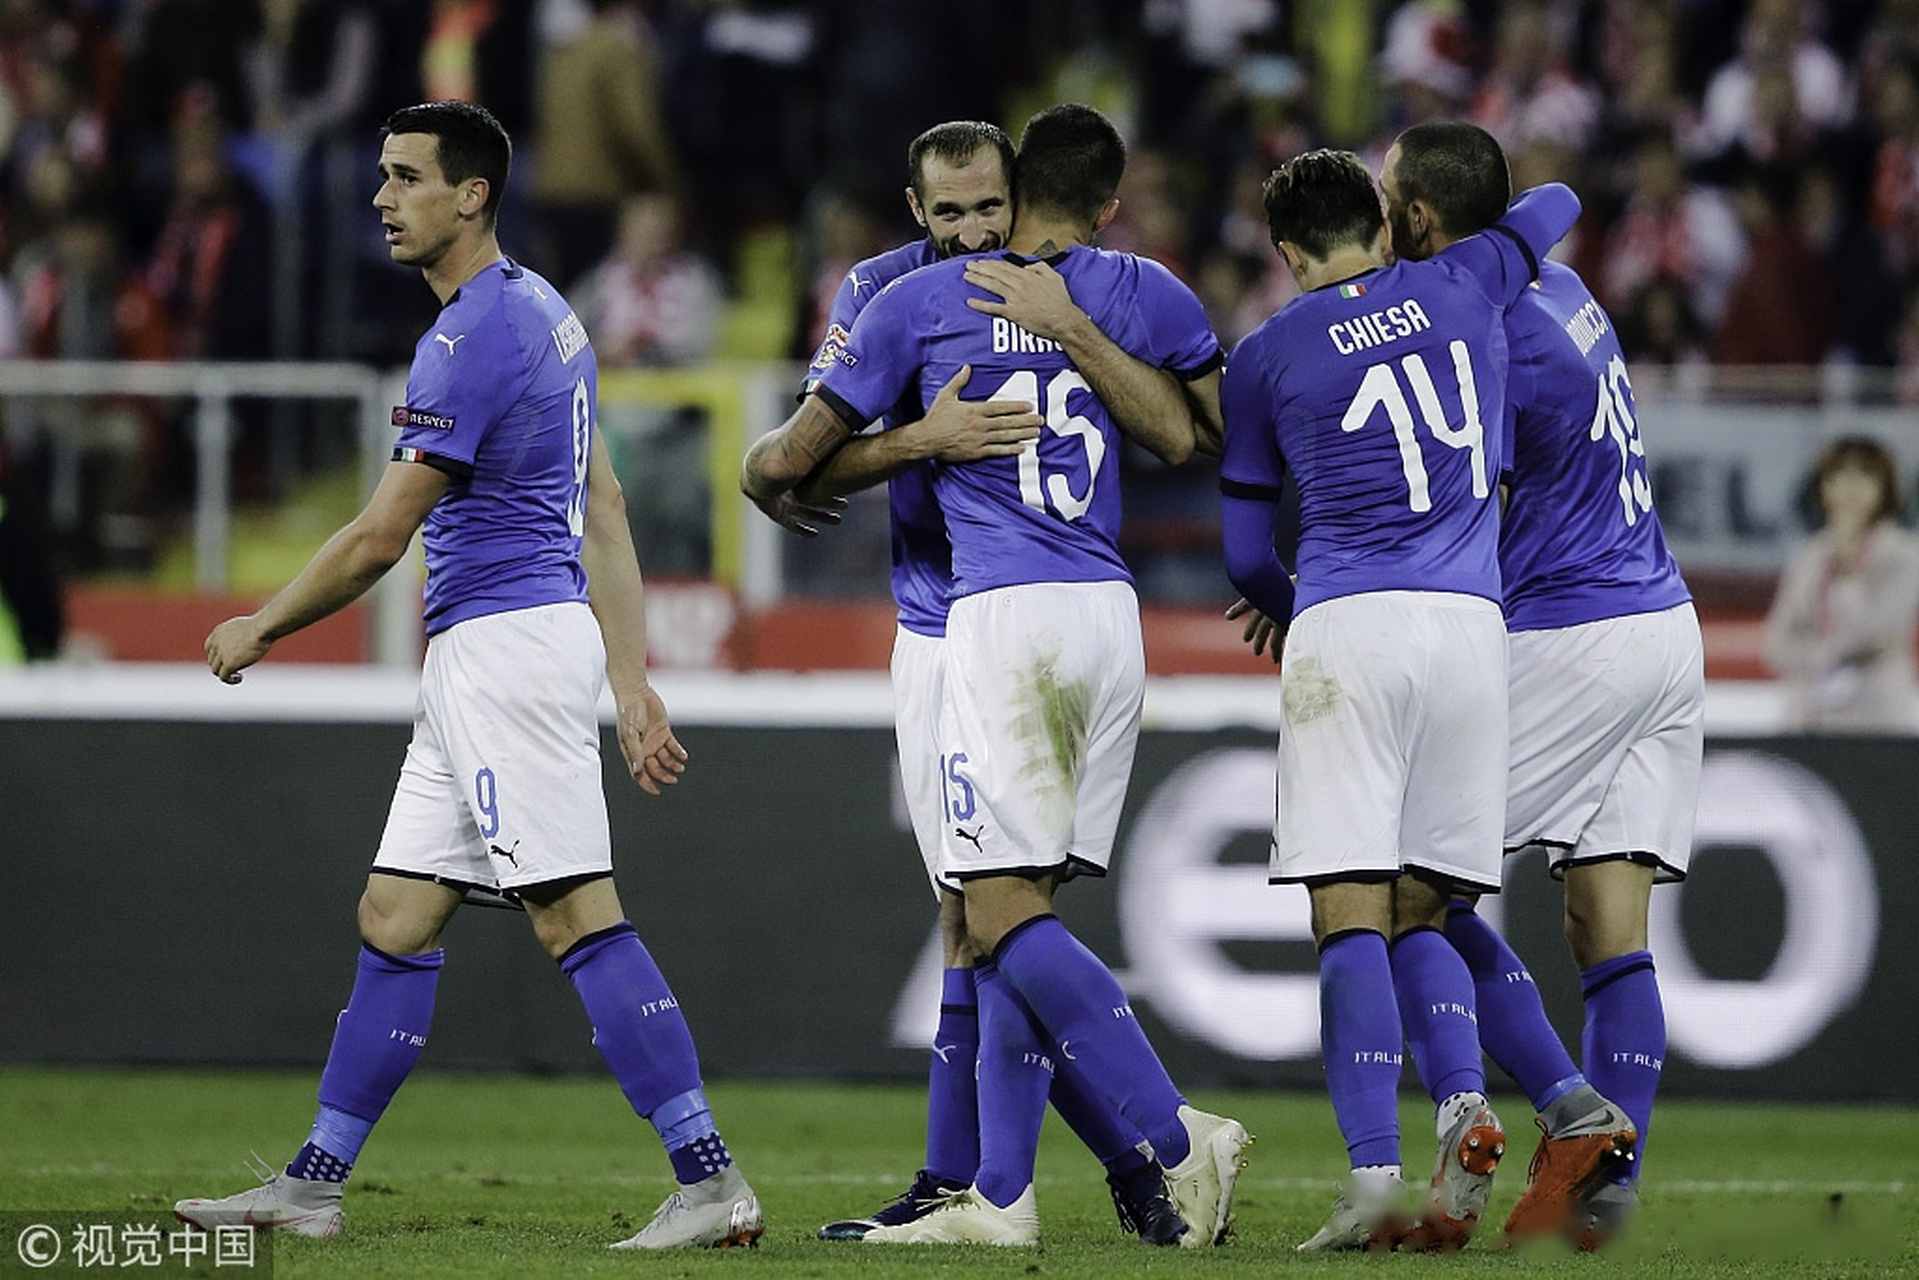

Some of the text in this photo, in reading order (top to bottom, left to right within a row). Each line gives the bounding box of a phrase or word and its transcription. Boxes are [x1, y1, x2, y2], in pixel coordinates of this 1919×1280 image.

[1328, 300, 1431, 355] CHIESA
[409, 413, 454, 430] RESPECT
[568, 376, 590, 538] 9
[987, 369, 1106, 522] 15
[1341, 340, 1489, 513] 14
[1590, 354, 1652, 527] 19
[476, 766, 499, 840] 9
[941, 752, 976, 823] 15
